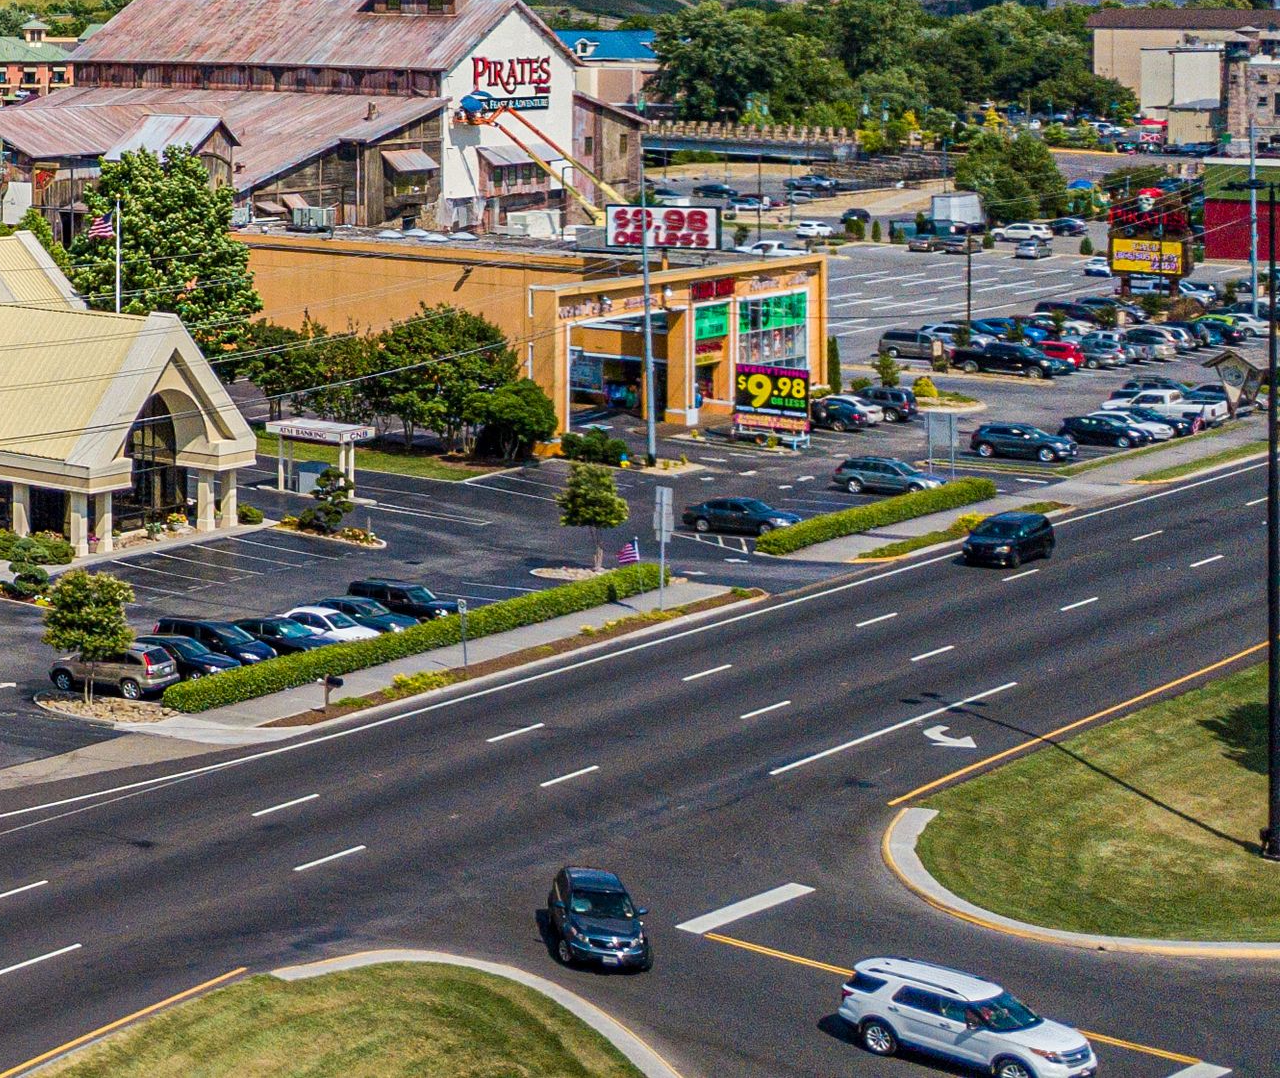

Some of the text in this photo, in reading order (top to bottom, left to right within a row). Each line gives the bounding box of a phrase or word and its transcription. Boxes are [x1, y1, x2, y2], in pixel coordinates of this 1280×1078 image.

[471, 56, 551, 95] PIRATES
[737, 373, 806, 408] $9.98
[785, 398, 806, 408] LESS
[296, 429, 326, 439] BANKING
